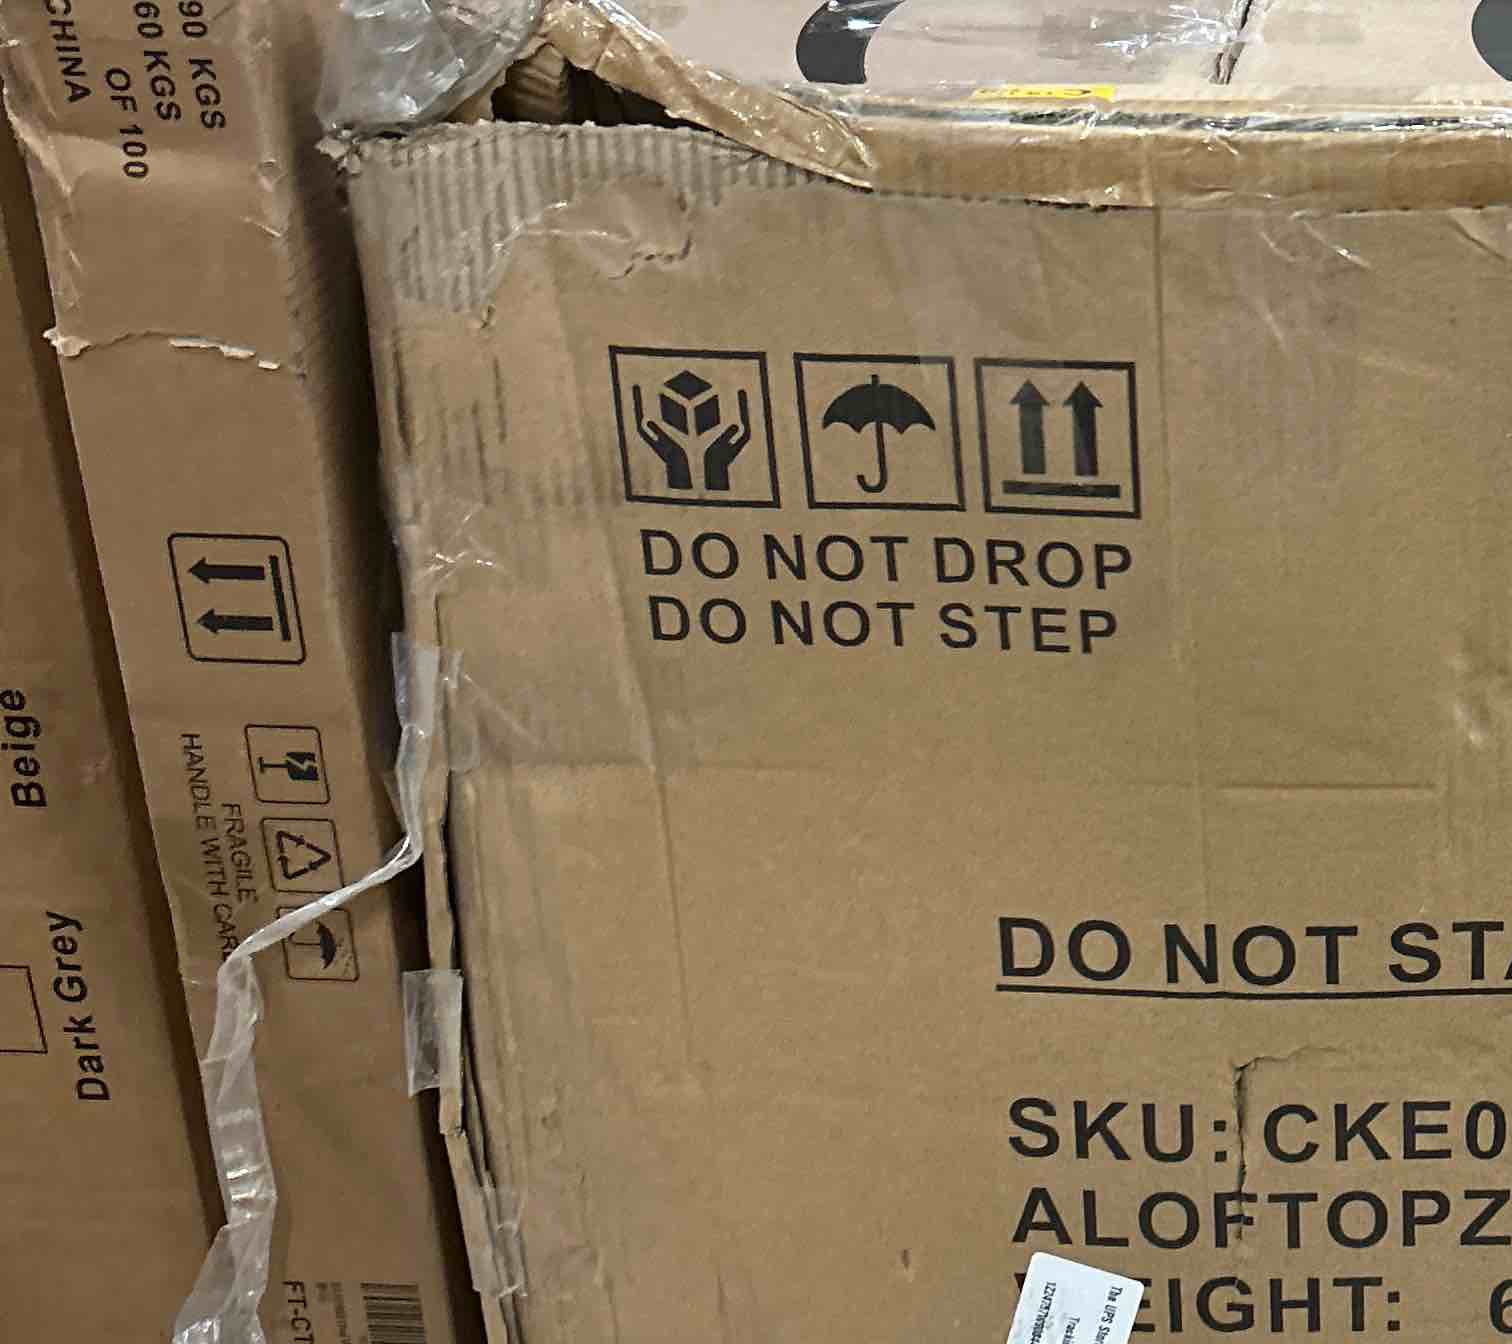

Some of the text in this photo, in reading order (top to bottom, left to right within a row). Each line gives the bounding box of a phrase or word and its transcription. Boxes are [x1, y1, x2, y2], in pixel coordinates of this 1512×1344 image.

[104, 68, 138, 113] OF
[143, 50, 181, 121] KGS
[188, 57, 226, 130] KGS
[119, 124, 149, 180] 100
[641, 529, 1133, 591] DO NOT DROP
[648, 596, 1118, 655] DO NOT STEP
[0, 688, 48, 808] Beige
[180, 733, 240, 961] HANDLE WITH CAR
[221, 803, 258, 903] FRAGILE
[999, 916, 1132, 982] DO
[1163, 922, 1358, 986] NOT
[45, 911, 110, 1102] Dark Grey
[1007, 1096, 1229, 1163] SKU:
[1011, 1187, 1512, 1250] ALOFTOPZ
[1101, 1304, 1118, 1325] UPS
[1105, 1285, 1123, 1302] The
